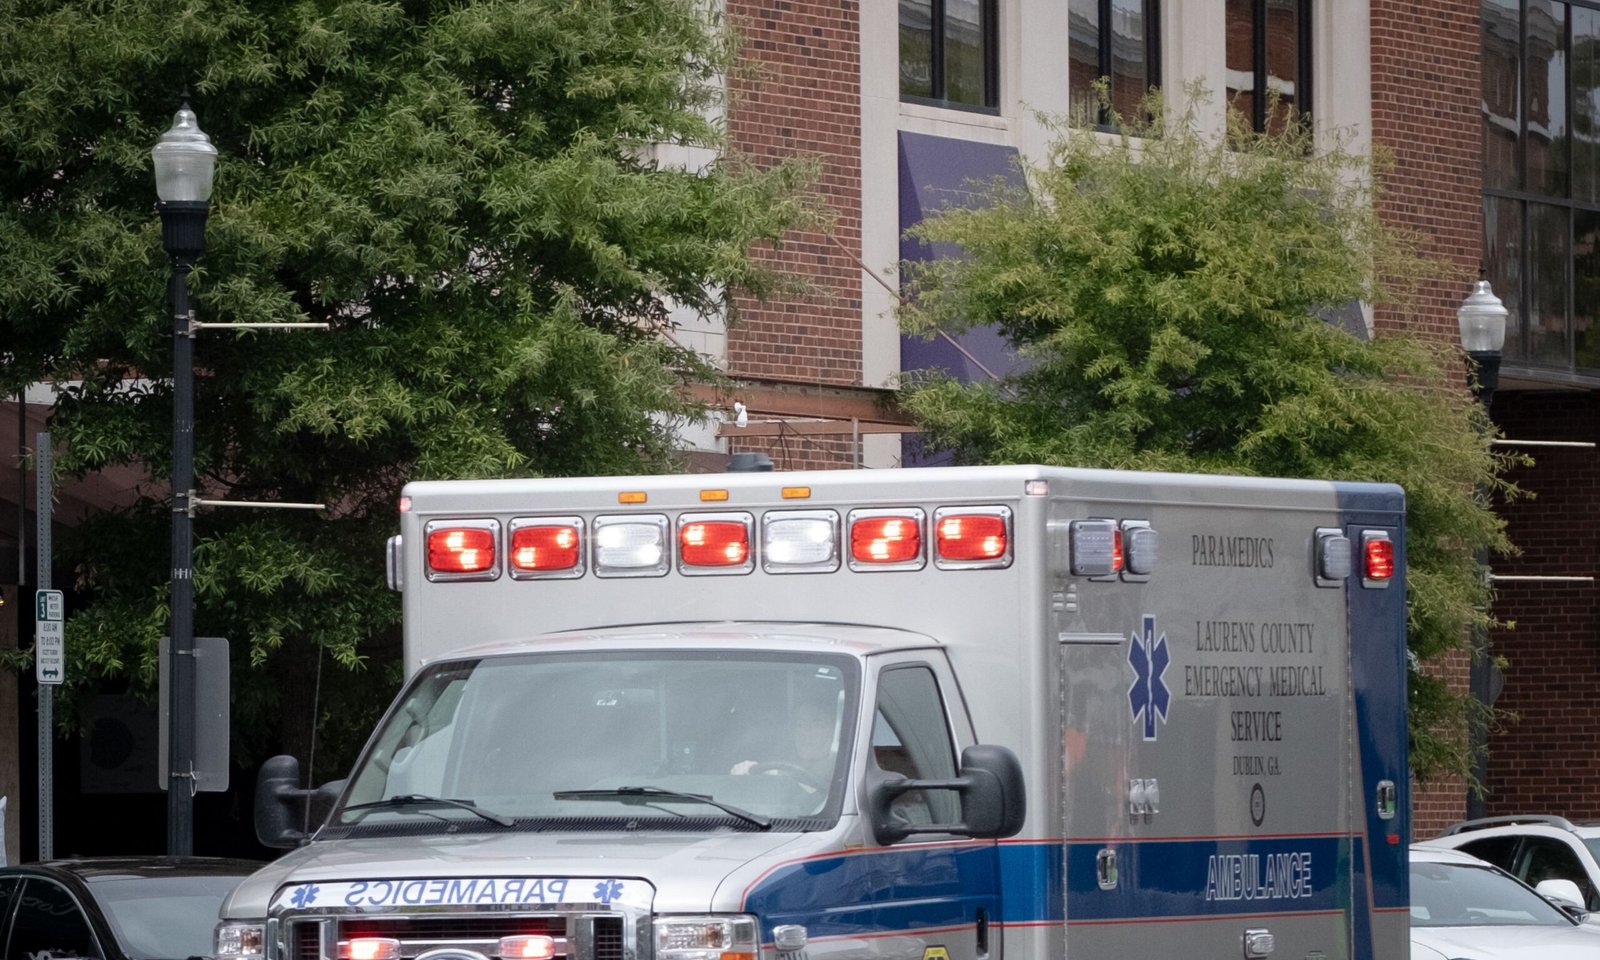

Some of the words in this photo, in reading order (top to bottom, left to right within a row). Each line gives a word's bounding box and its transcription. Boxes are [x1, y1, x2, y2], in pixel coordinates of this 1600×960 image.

[1192, 534, 1274, 569] PARAMEDICS
[1196, 621, 1255, 653] LAURENS
[1261, 622, 1315, 654] COUNTY
[1185, 665, 1263, 697] EMERGENCY
[1269, 665, 1326, 697] MEDICAL
[1230, 711, 1282, 742] SERVICE
[1233, 756, 1265, 777] DUBLIN,
[1267, 757, 1282, 776] GA.
[1205, 852, 1312, 901] AMBULANCE
